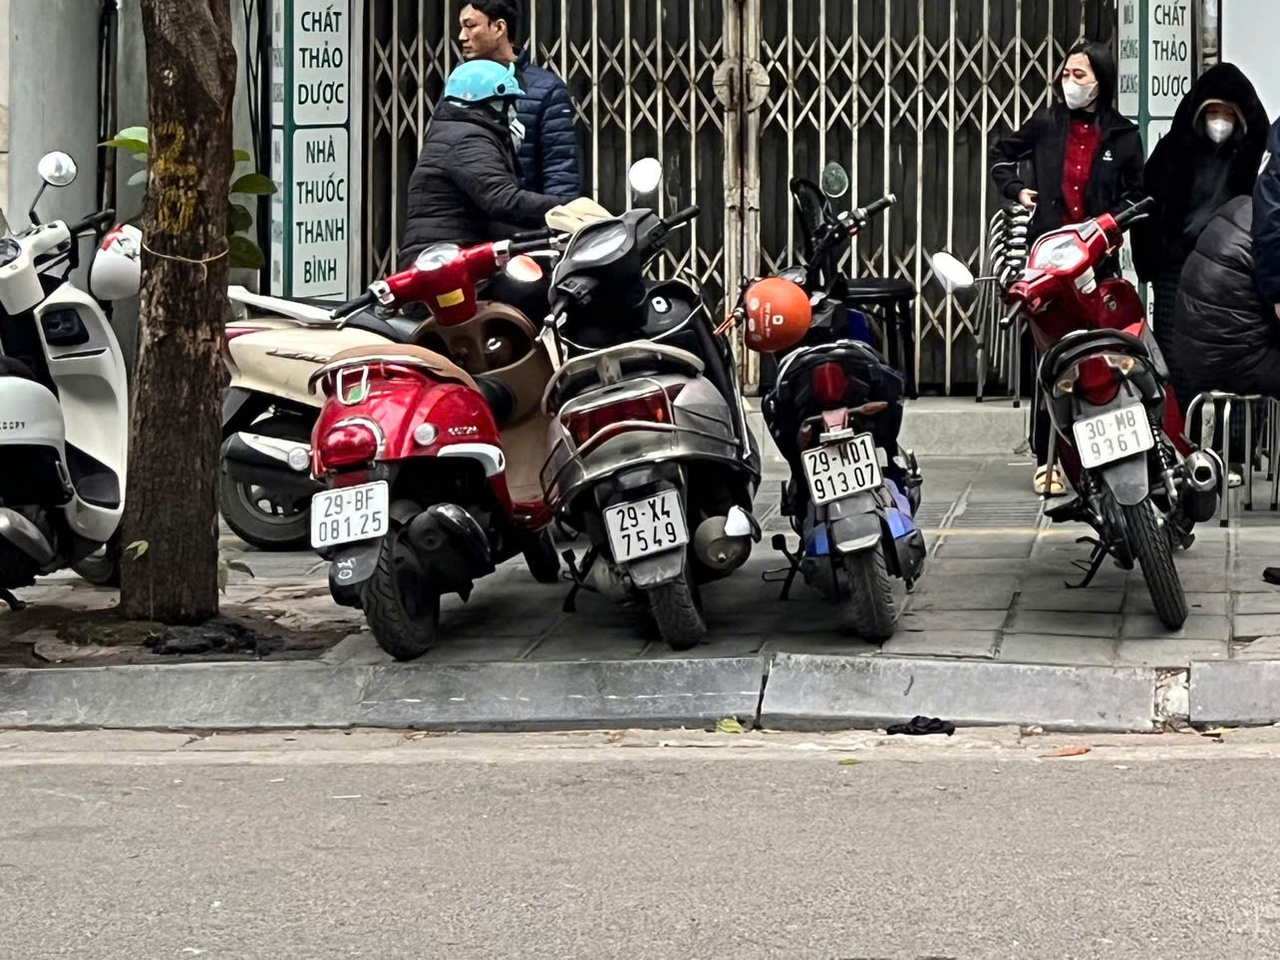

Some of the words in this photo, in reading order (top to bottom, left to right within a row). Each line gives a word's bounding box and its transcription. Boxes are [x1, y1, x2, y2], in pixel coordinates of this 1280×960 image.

[301, 5, 342, 33] CHẤT
[1154, 0, 1187, 26] CHẤT
[299, 41, 343, 69] THẢO
[1153, 34, 1187, 61] THẢO
[298, 82, 344, 110] DƯỢC
[1152, 75, 1188, 102] DƯỢC
[306, 134, 336, 164] NHÀ
[297, 171, 345, 204] THUỐC
[296, 218, 345, 244] THANH
[304, 258, 337, 284] BÌNH
[809, 439, 869, 476] 29-MD1
[1091, 430, 1140, 459] 9361
[815, 463, 874, 499] 913.07
[324, 488, 374, 517] 29-BF
[616, 496, 670, 531] 29-X4
[319, 511, 382, 542] 081.25
[622, 522, 676, 556] 7549
